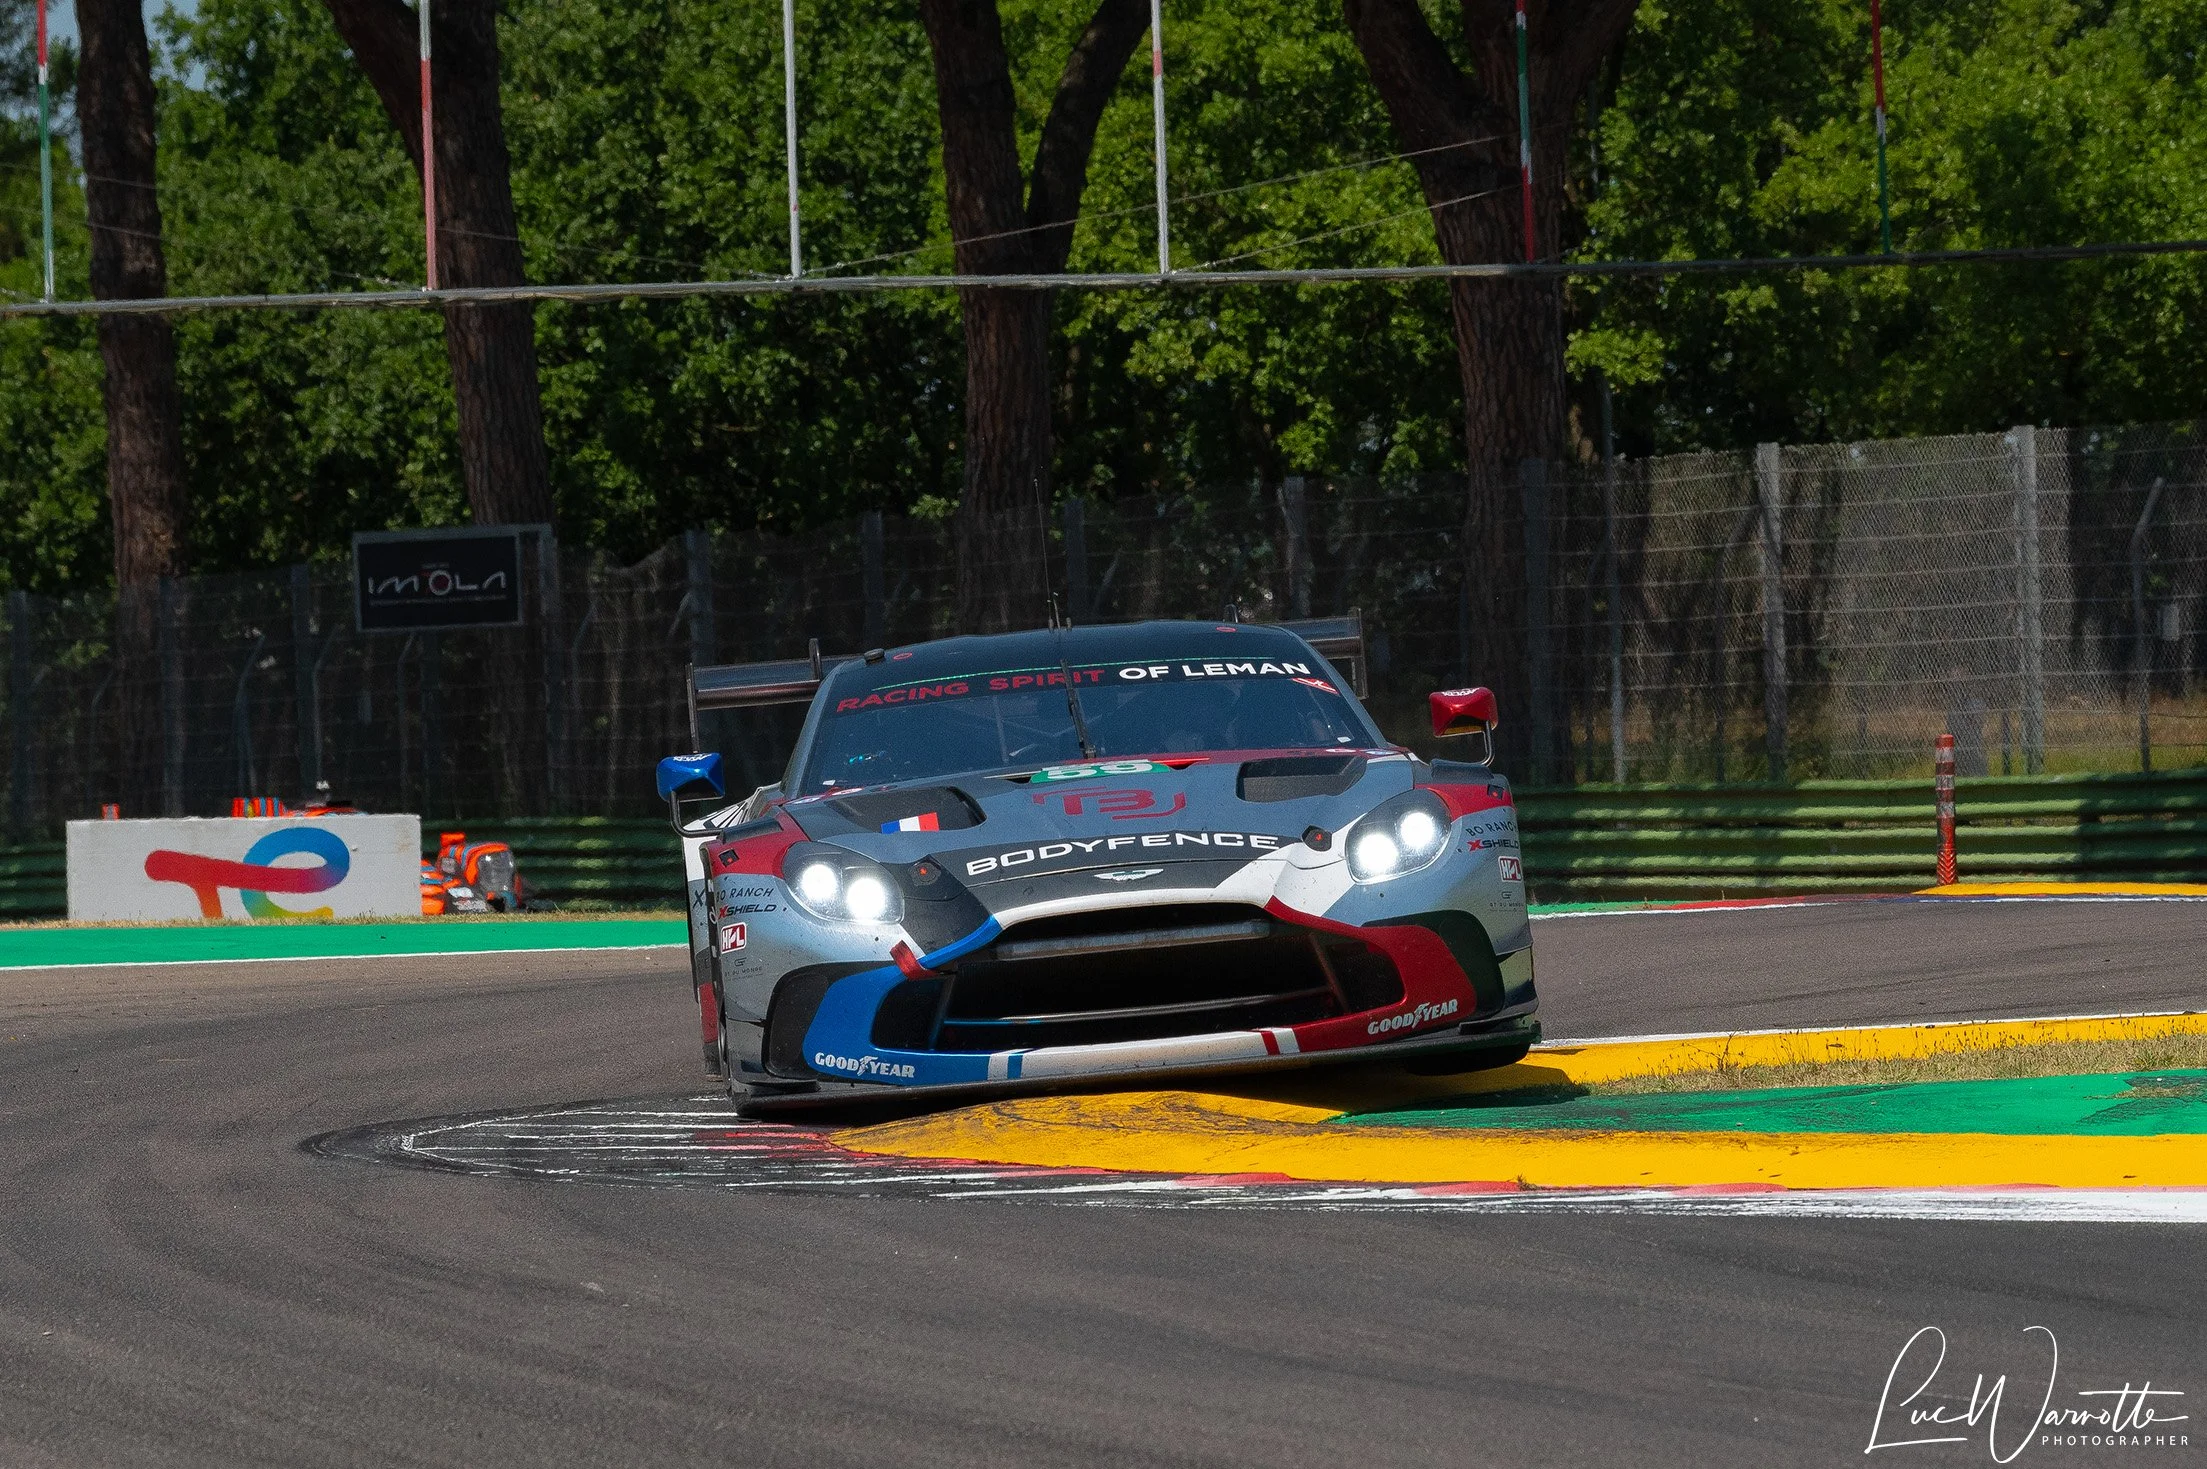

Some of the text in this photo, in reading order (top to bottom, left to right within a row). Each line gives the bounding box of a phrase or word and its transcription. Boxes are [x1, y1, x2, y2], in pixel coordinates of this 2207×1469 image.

[836, 662, 1312, 712] RACING SPIRIT OF LEMAN
[1042, 758, 1153, 779] 59
[1466, 825, 1484, 837] BO
[966, 832, 1280, 876] BODYFENCE
[1467, 839, 1519, 853] XSHIELD
[729, 887, 774, 899] RANCH
[718, 904, 777, 920] XSHIELD
[1367, 999, 1458, 1035] GOODYEAR
[815, 1052, 915, 1078] GOODYEAR
